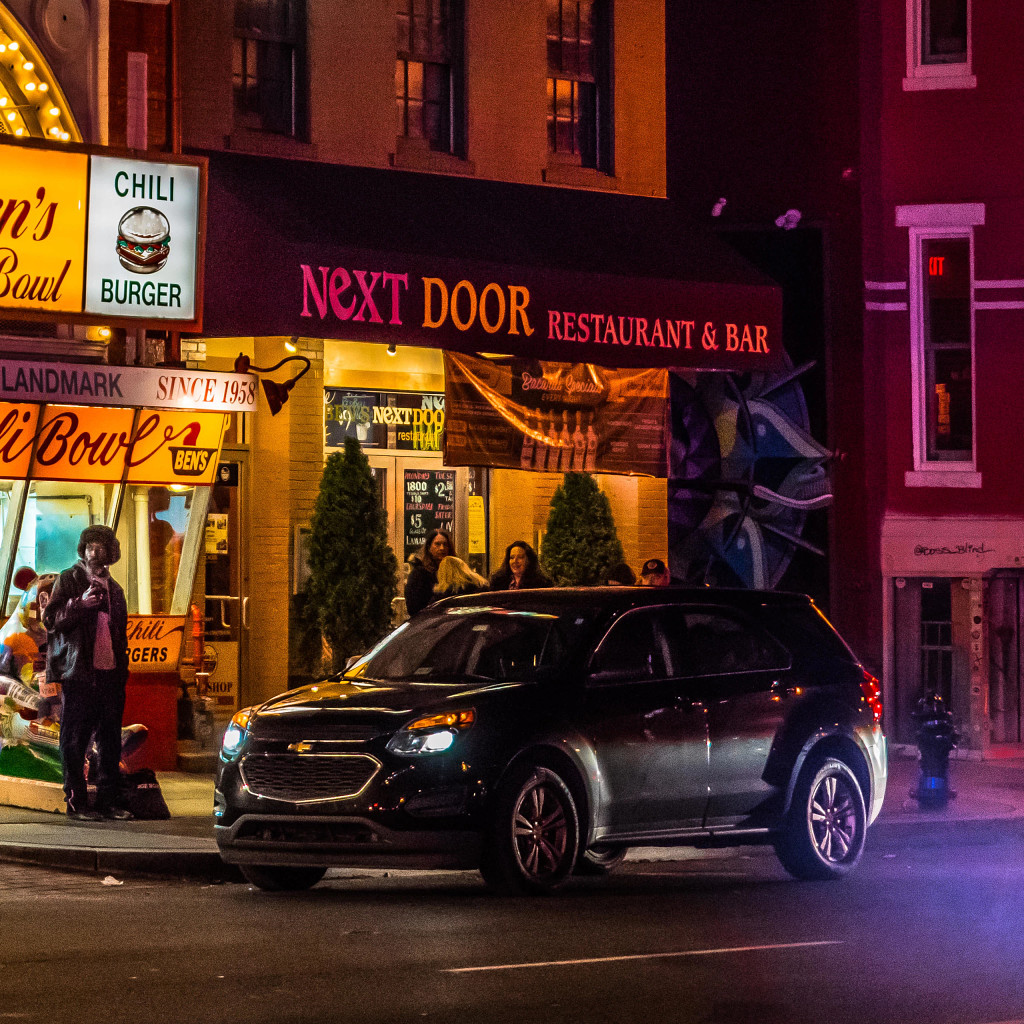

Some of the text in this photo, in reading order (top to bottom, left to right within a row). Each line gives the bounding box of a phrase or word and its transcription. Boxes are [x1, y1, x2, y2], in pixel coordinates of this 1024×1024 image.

[114, 170, 174, 202] CHILI
[100, 278, 182, 308] BURGER
[421, 276, 535, 337] DOOR
[547, 310, 695, 350] RESTAURANT
[702, 321, 719, 351] &
[725, 322, 770, 354] BAR
[2, 366, 124, 398] LANDMARK
[156, 375, 256, 405] SINCE 1958
[412, 408, 445, 426] DOO
[35, 411, 166, 468] Bowl
[174, 449, 208, 472] BEN'S
[407, 481, 427, 492] 1800
[206, 681, 234, 693] SHOP
